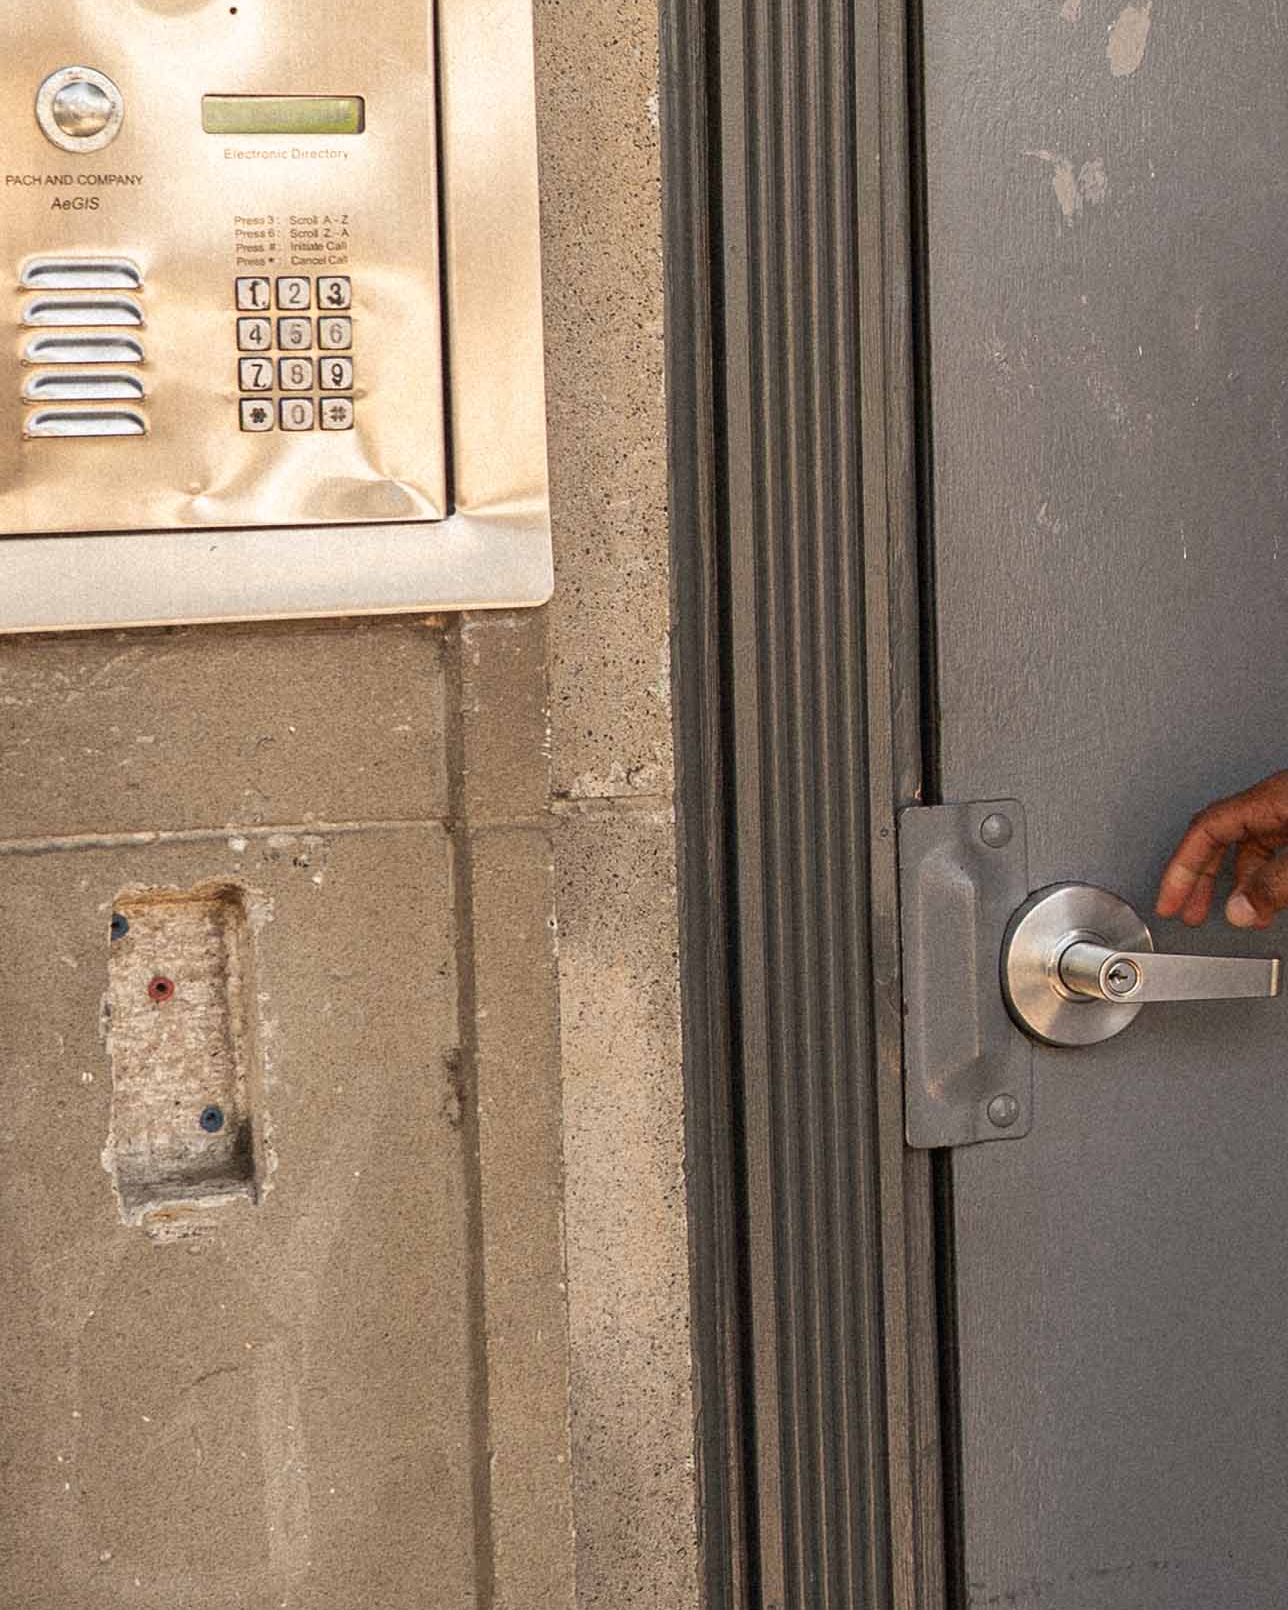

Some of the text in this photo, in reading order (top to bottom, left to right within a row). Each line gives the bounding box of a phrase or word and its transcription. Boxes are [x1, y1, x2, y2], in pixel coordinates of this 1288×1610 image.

[223, 148, 349, 160] Electronic Directory
[5, 174, 144, 186] PACH AND COMPANY
[50, 196, 101, 211] AeGIS
[234, 215, 265, 225] Press
[289, 215, 318, 225] Scroll
[235, 229, 266, 239] Press
[290, 228, 319, 238] Scroll
[236, 243, 265, 253] Press
[291, 241, 324, 251] Initiate
[326, 241, 348, 251] Call
[237, 257, 266, 266] Press
[291, 255, 326, 265] Cancel
[328, 255, 349, 265] Call
[249, 280, 343, 307] 1 2 3
[249, 323, 343, 344] 4 5 6
[251, 363, 344, 388] 7 8 9
[291, 404, 305, 425] 0
